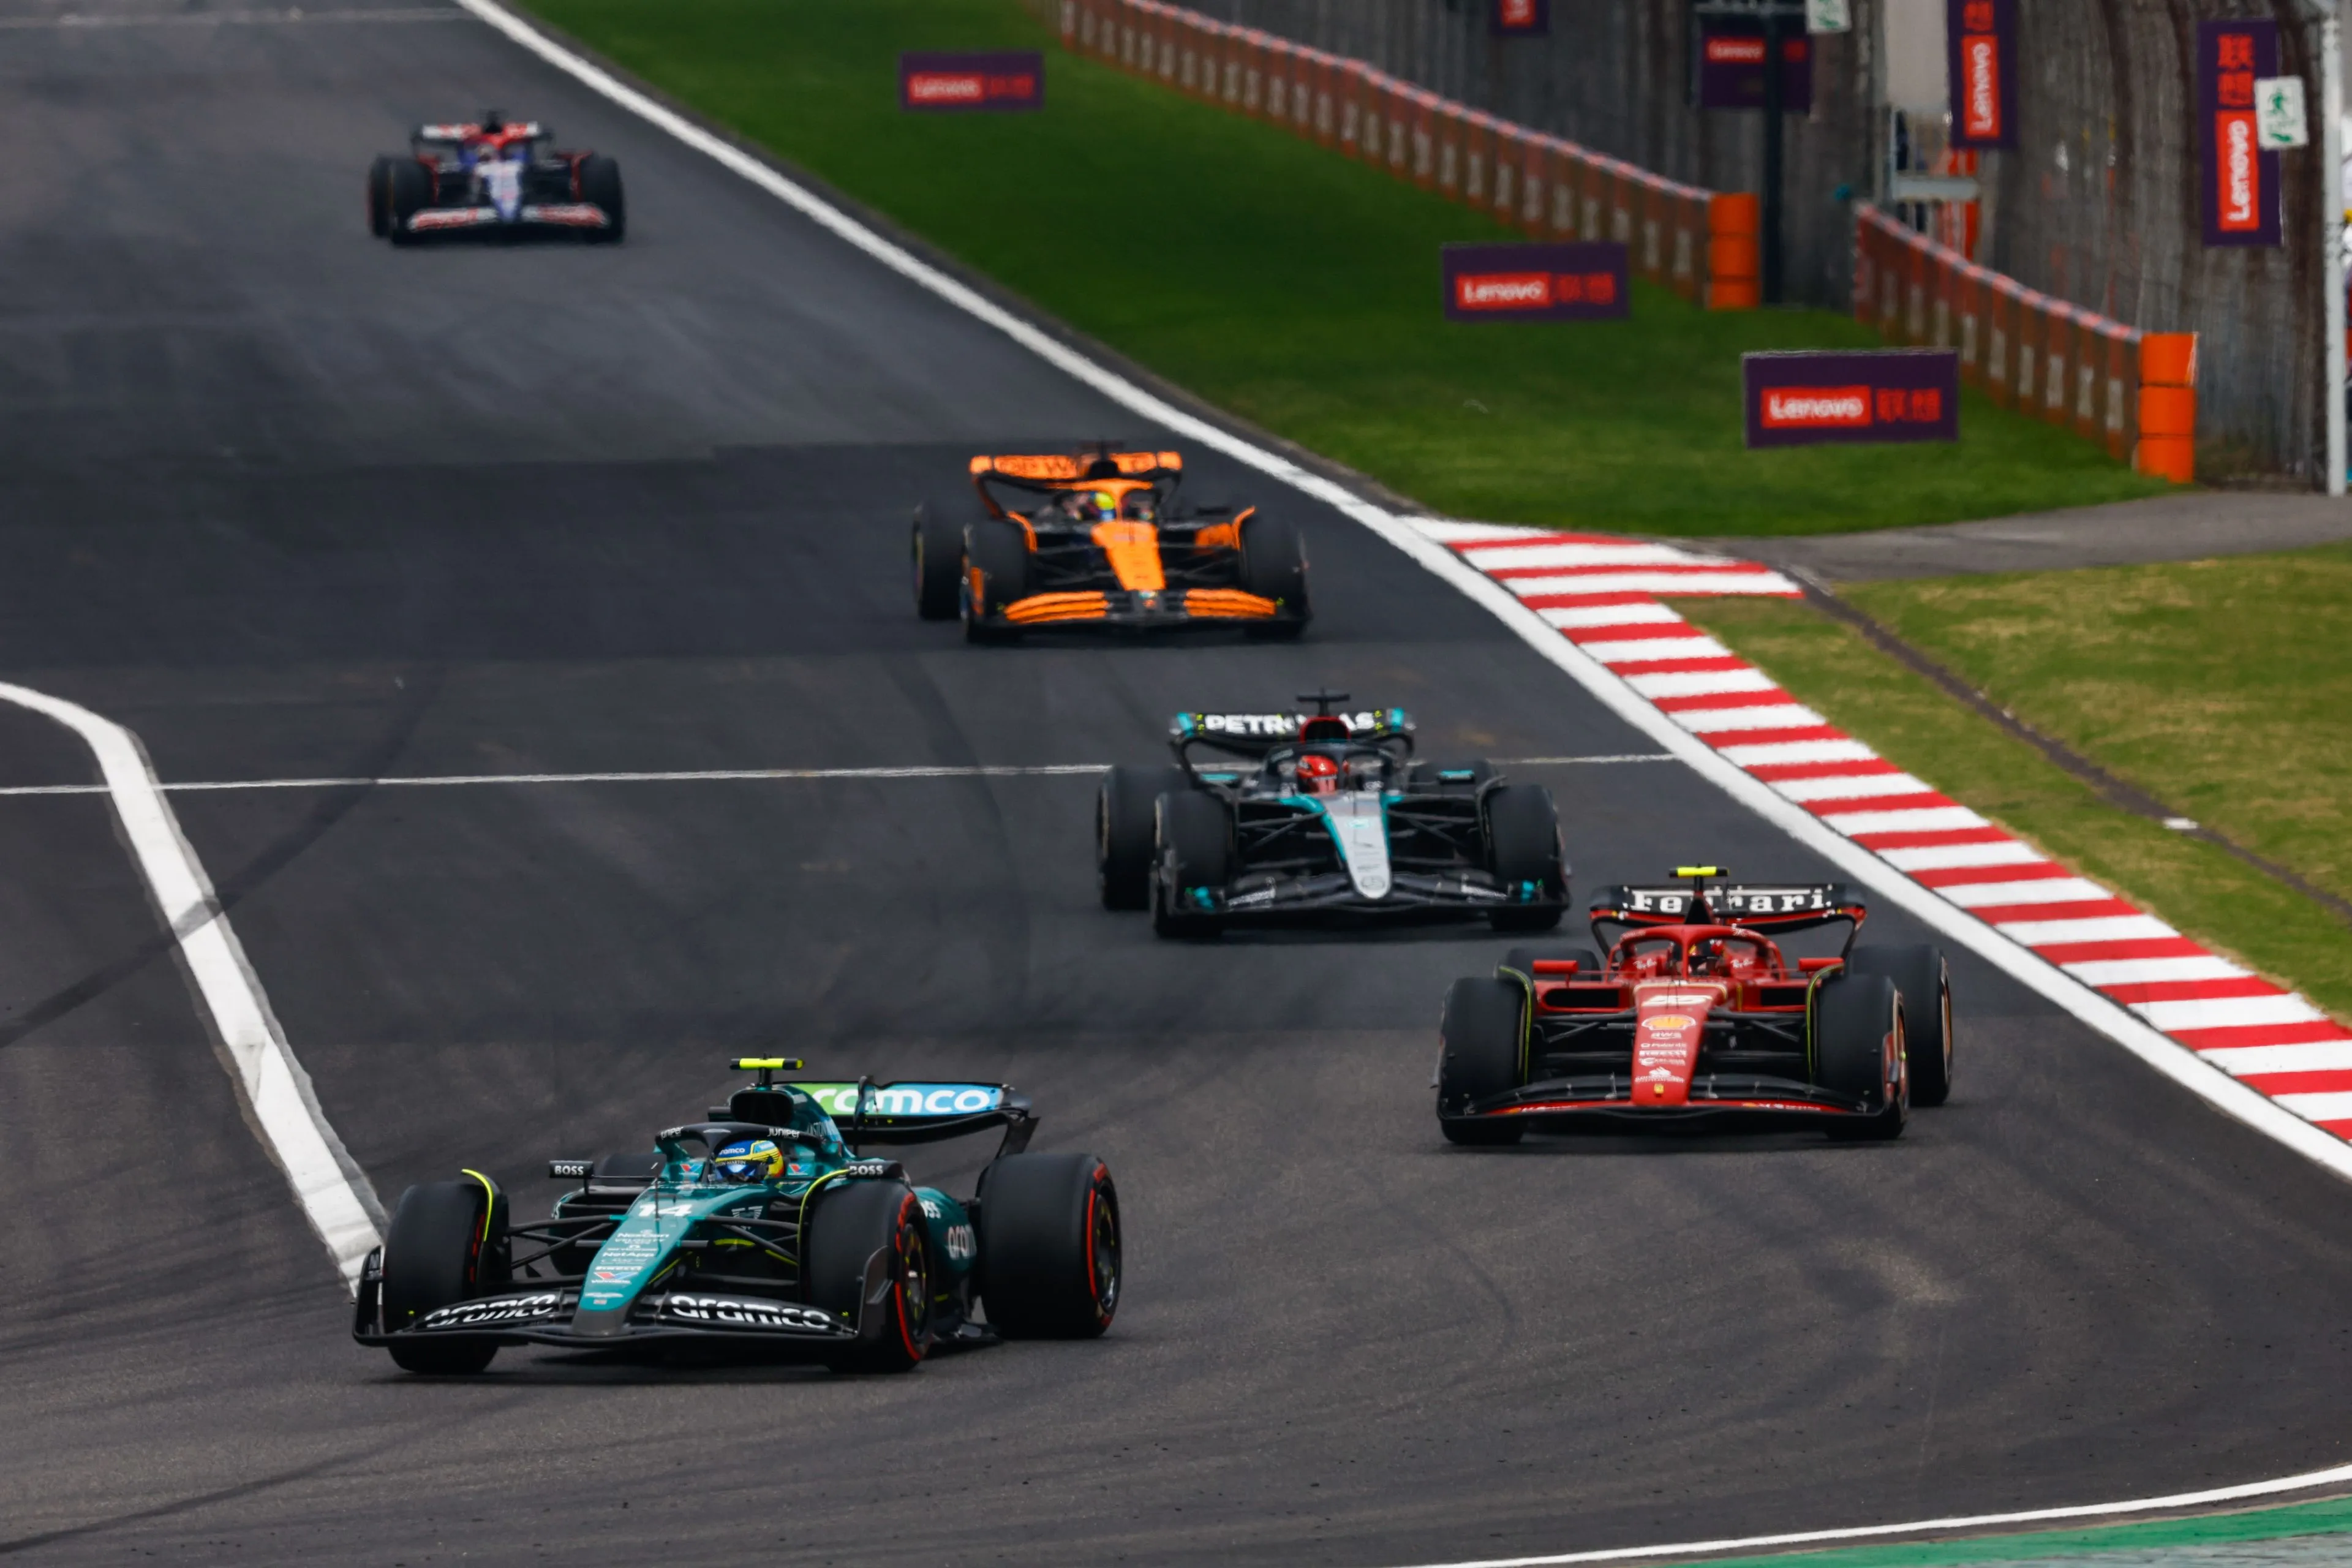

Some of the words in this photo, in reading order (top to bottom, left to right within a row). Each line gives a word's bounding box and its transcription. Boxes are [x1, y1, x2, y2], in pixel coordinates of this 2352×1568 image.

[1971, 42, 1992, 132] Lenovo
[2226, 119, 2250, 221] Lenovo
[1464, 279, 1545, 303] Lenovo
[1770, 394, 1864, 420] Lenovo
[812, 1088, 990, 1114] ramco
[554, 1165, 584, 1175] BOSS
[638, 1203, 692, 1217] 14
[671, 1295, 831, 1329] aramco
